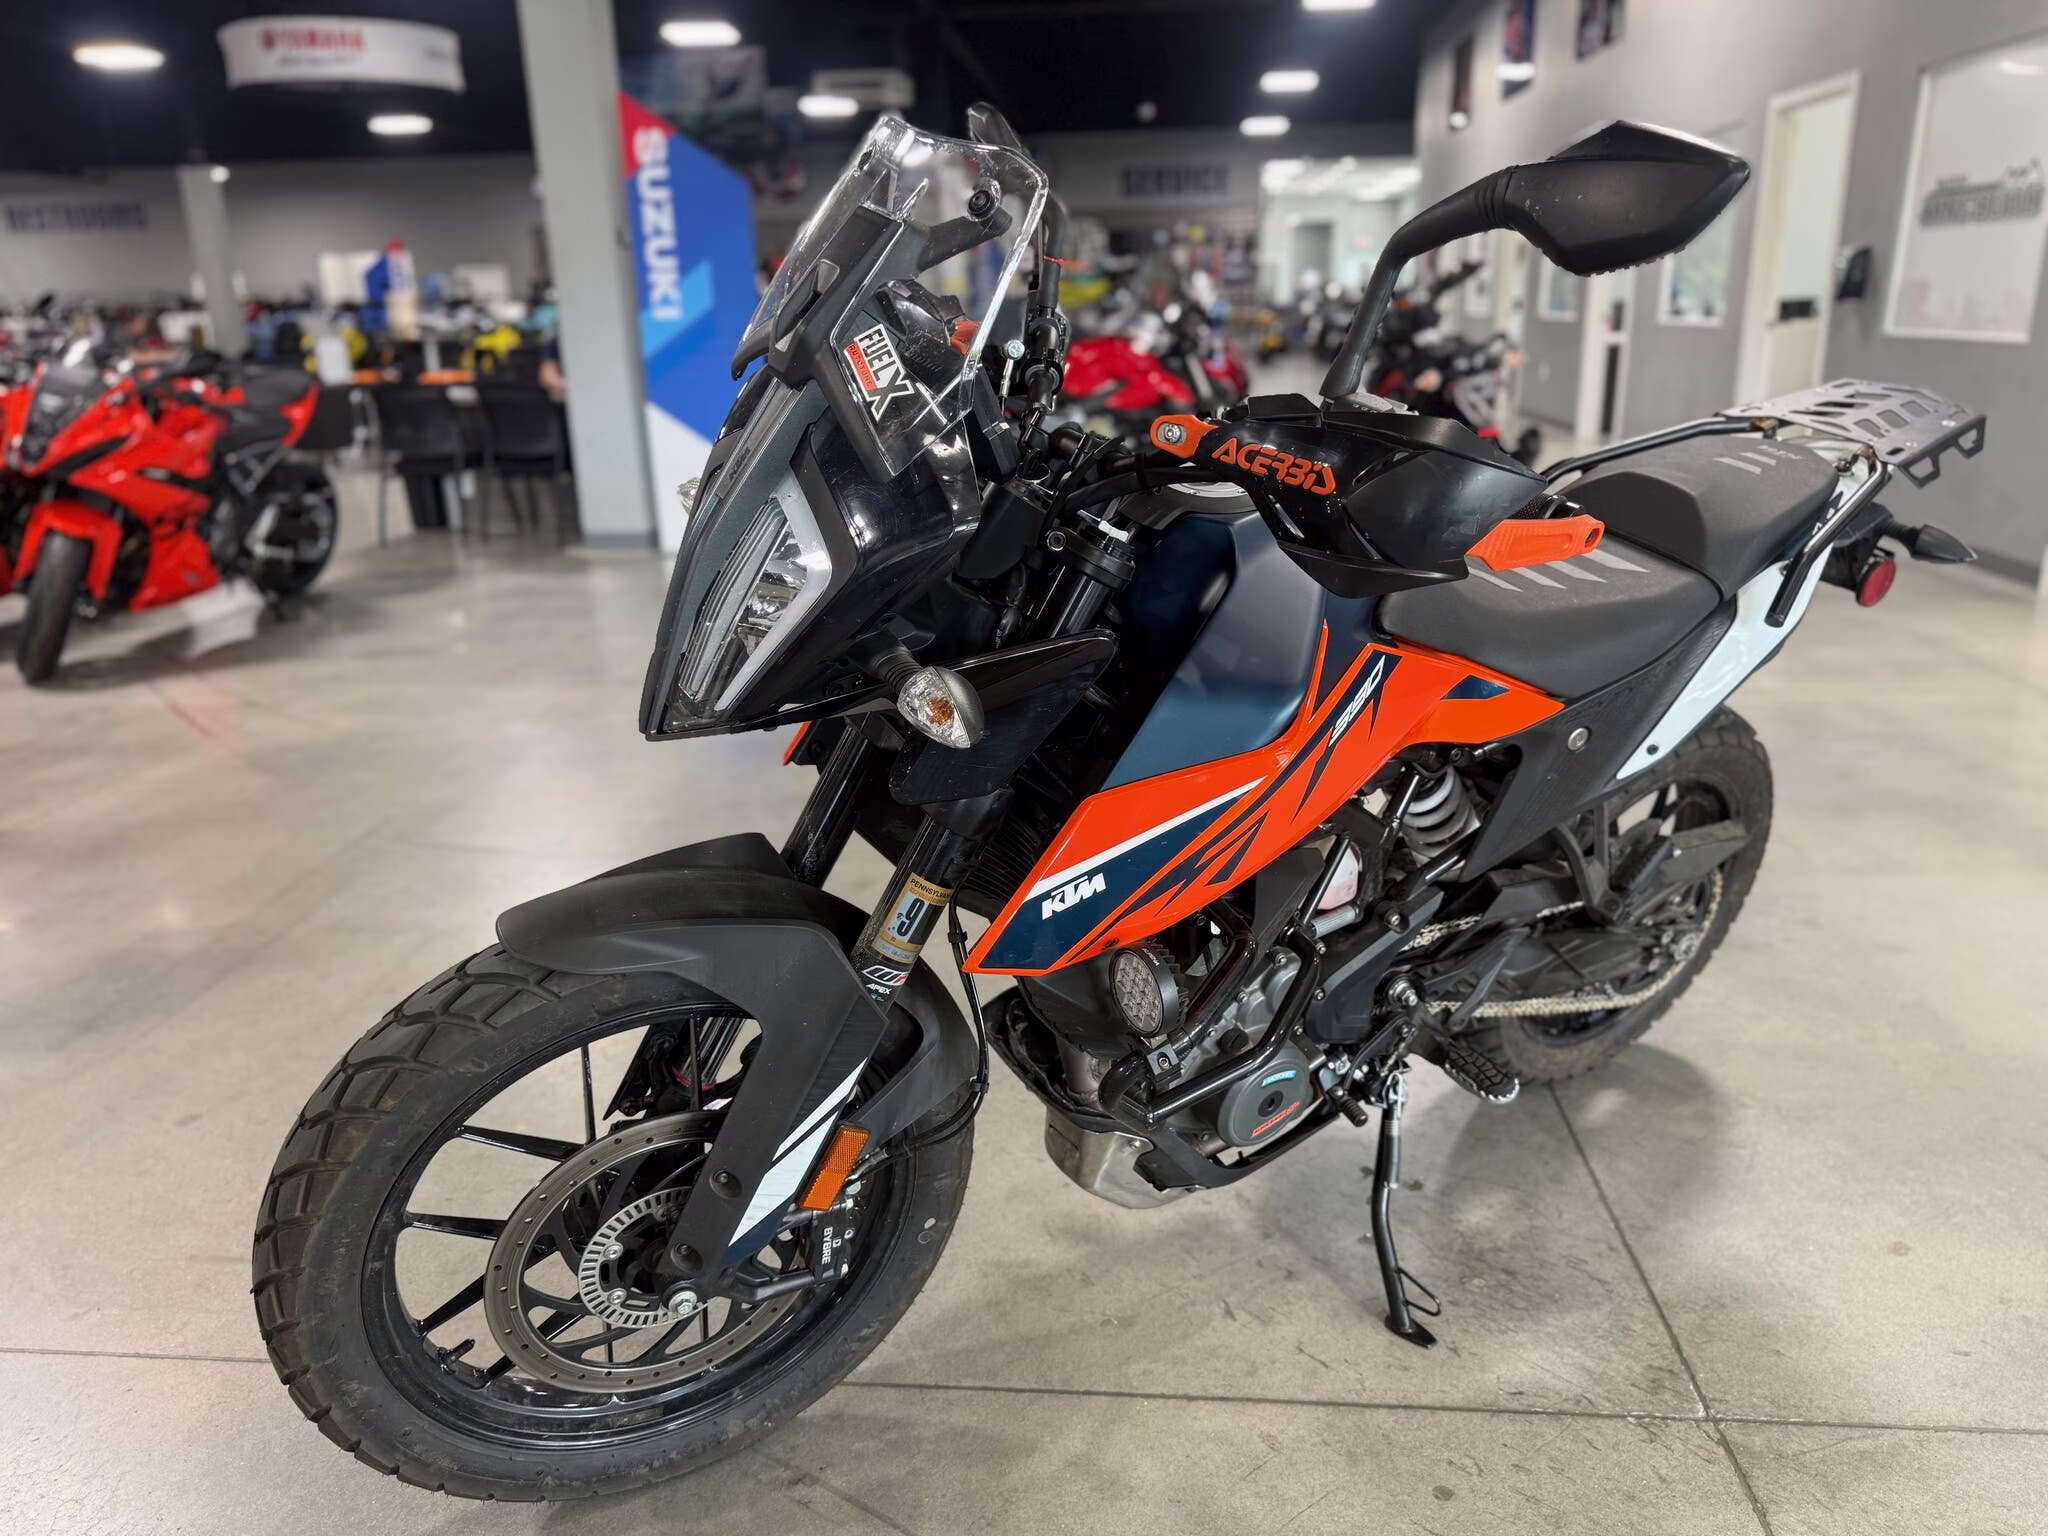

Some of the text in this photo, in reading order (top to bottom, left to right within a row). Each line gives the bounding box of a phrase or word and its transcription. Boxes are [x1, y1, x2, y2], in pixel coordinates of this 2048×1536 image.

[633, 126, 684, 321] SUZUKI
[1328, 655, 1386, 747] 390
[896, 897, 926, 937] 9
[1042, 872, 1107, 921] KTM
[865, 983, 893, 995] APEX
[821, 1226, 834, 1265] BYBRE
